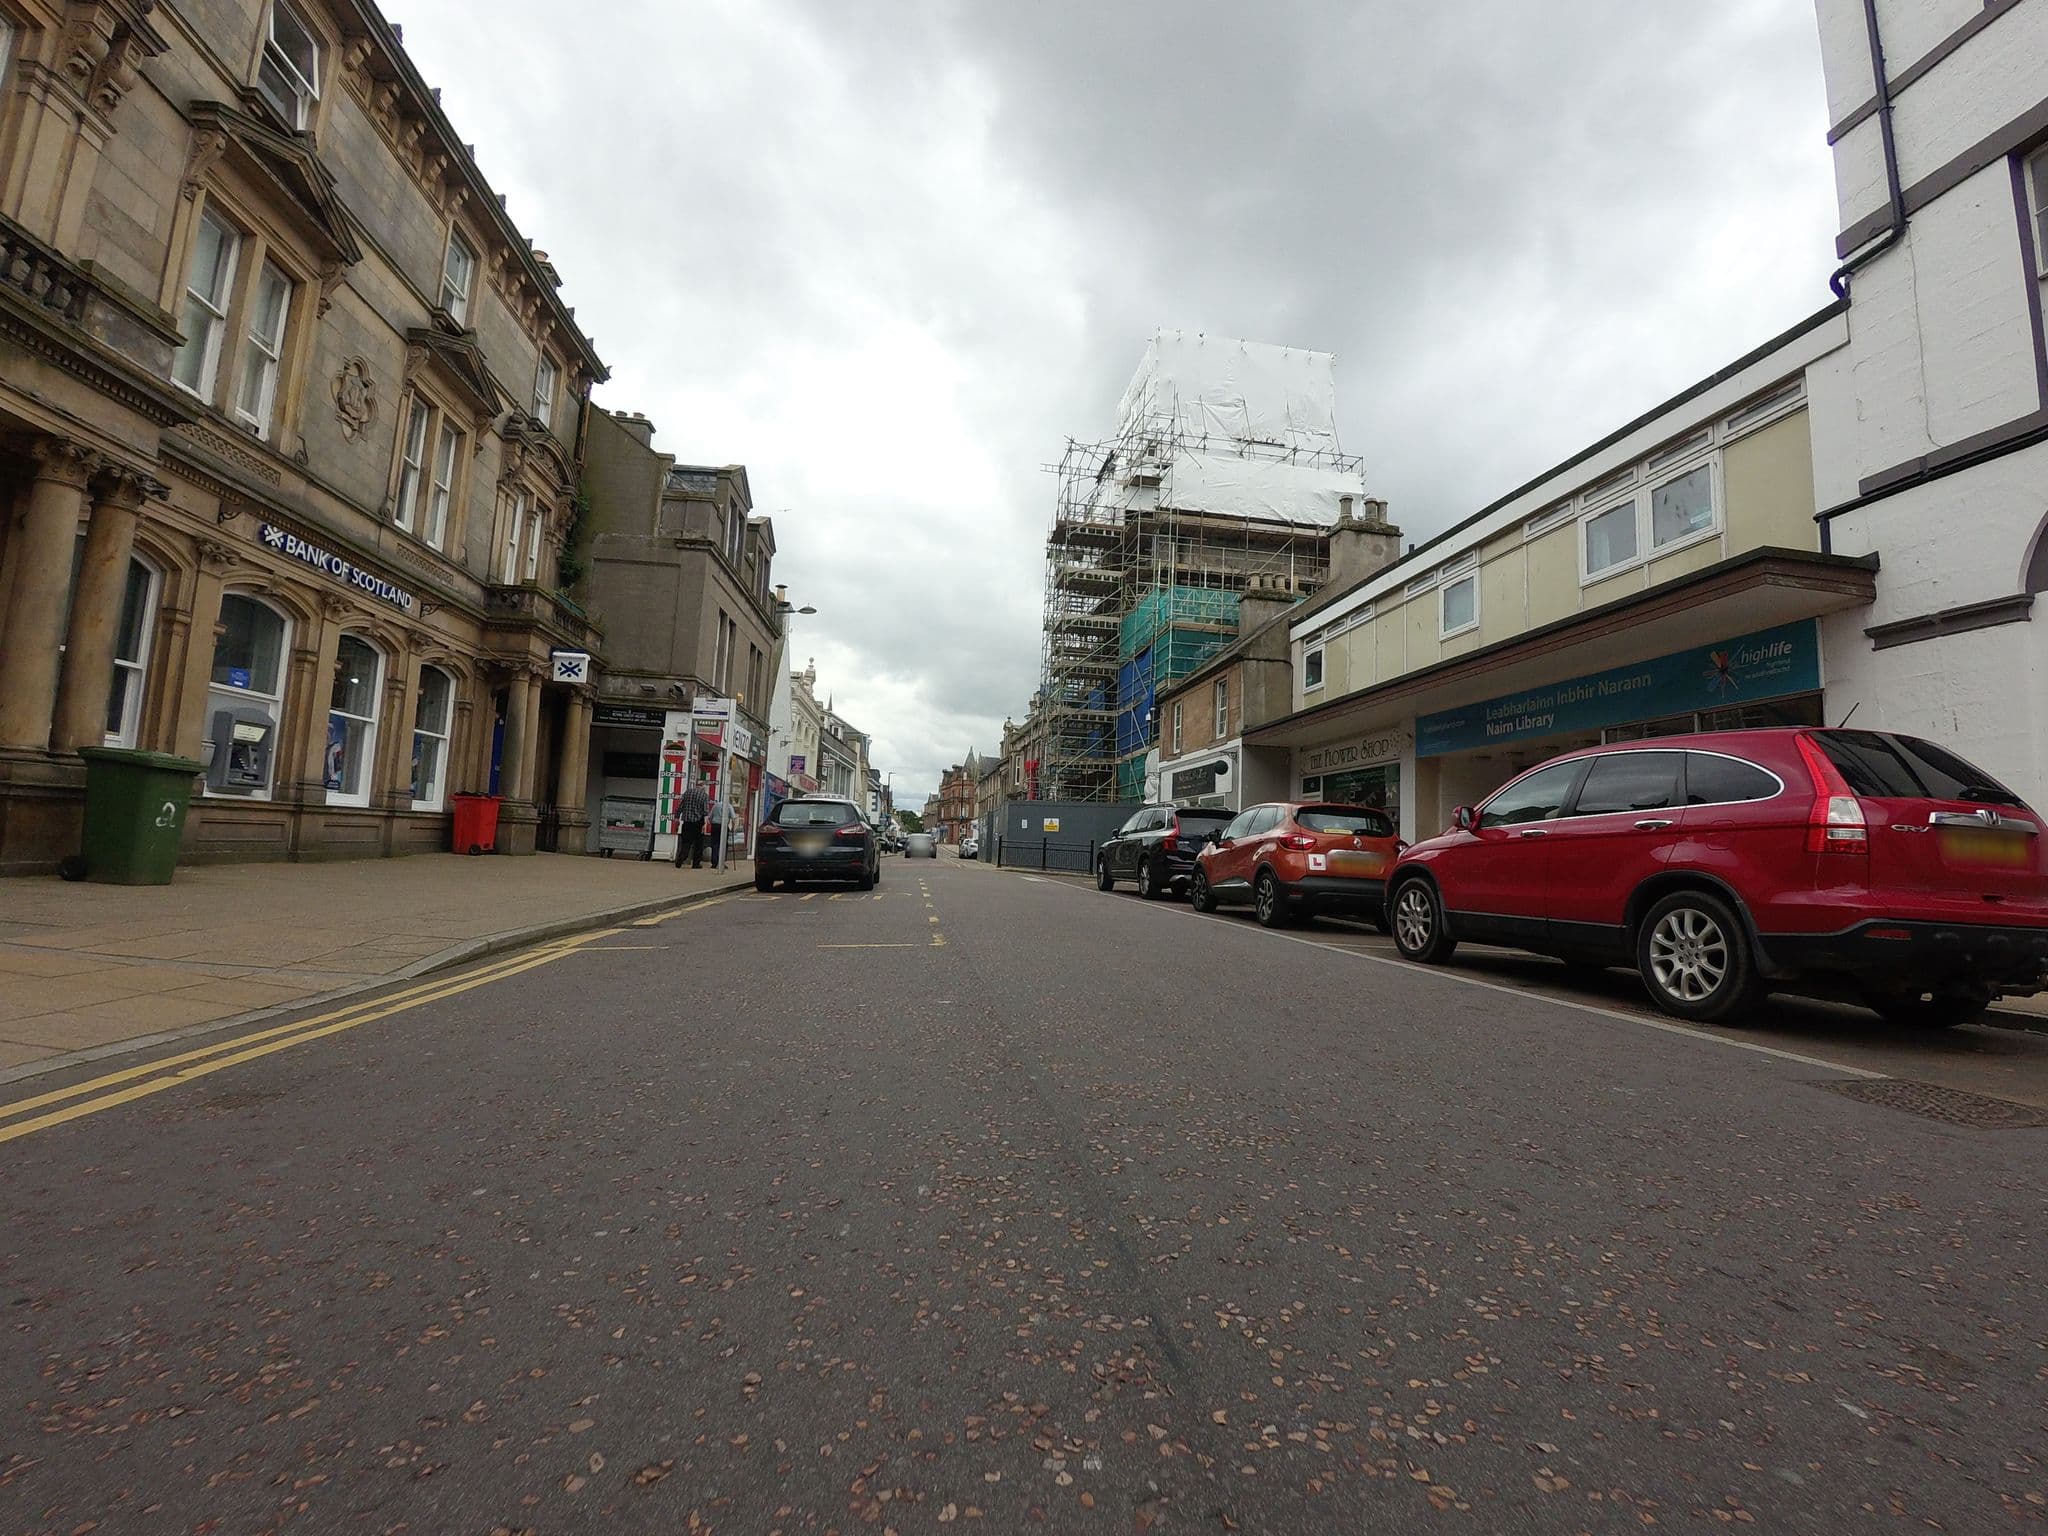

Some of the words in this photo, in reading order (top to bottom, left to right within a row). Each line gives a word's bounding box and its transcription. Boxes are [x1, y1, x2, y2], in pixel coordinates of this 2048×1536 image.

[286, 534, 330, 570] BANK
[331, 556, 349, 579] OF
[351, 567, 412, 609] SCOTLAND
[1741, 640, 1793, 665] highlife
[1486, 695, 1554, 721] Leabharlainn
[1557, 684, 1595, 705] Inbhir
[1598, 673, 1651, 696] Narann
[1486, 721, 1514, 737] Nairn
[1515, 713, 1555, 731] Library
[1311, 752, 1322, 769] THE
[1325, 746, 1359, 767] FLOWER
[1360, 739, 1390, 760] SHOP
